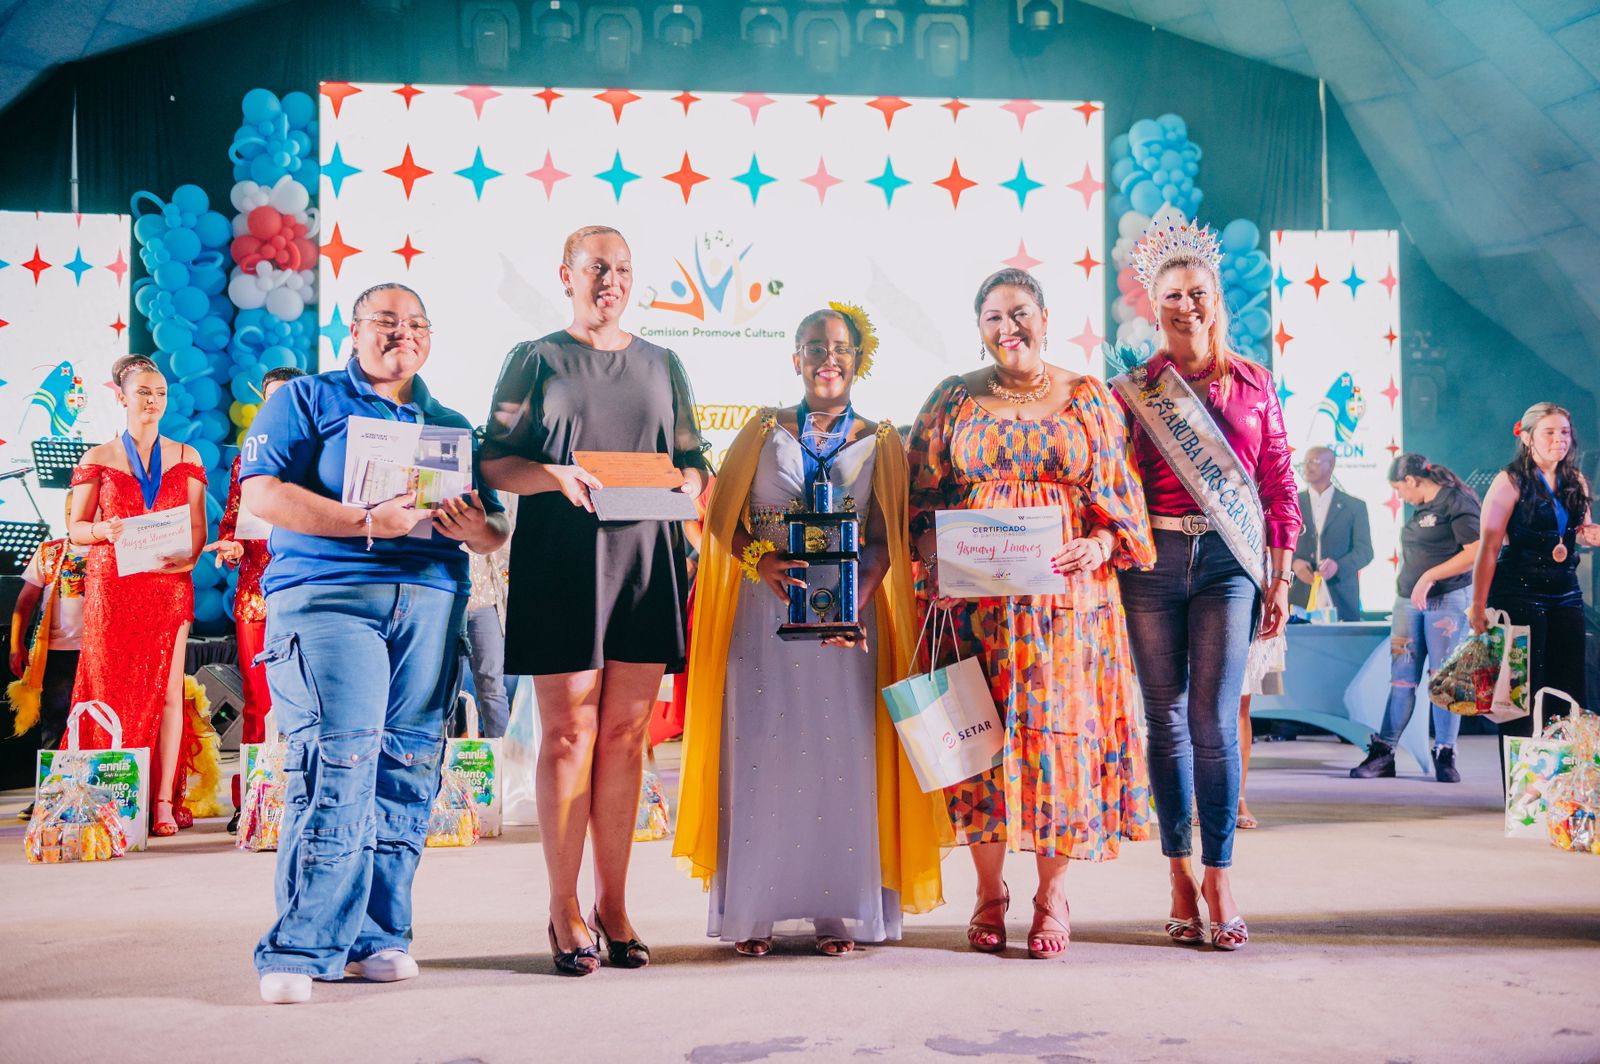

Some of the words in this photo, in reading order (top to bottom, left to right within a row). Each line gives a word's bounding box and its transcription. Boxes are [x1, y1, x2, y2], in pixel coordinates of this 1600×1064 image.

[640, 326, 689, 337] Comision
[693, 327, 741, 338] Promove
[745, 327, 785, 338] Cultura
[1163, 413, 1204, 462] ARUBA
[1195, 456, 1228, 492] MRS
[1219, 486, 1264, 555] CARNIVAL
[972, 525, 1026, 534] CERTIFICADO
[957, 720, 993, 741] SETAR
